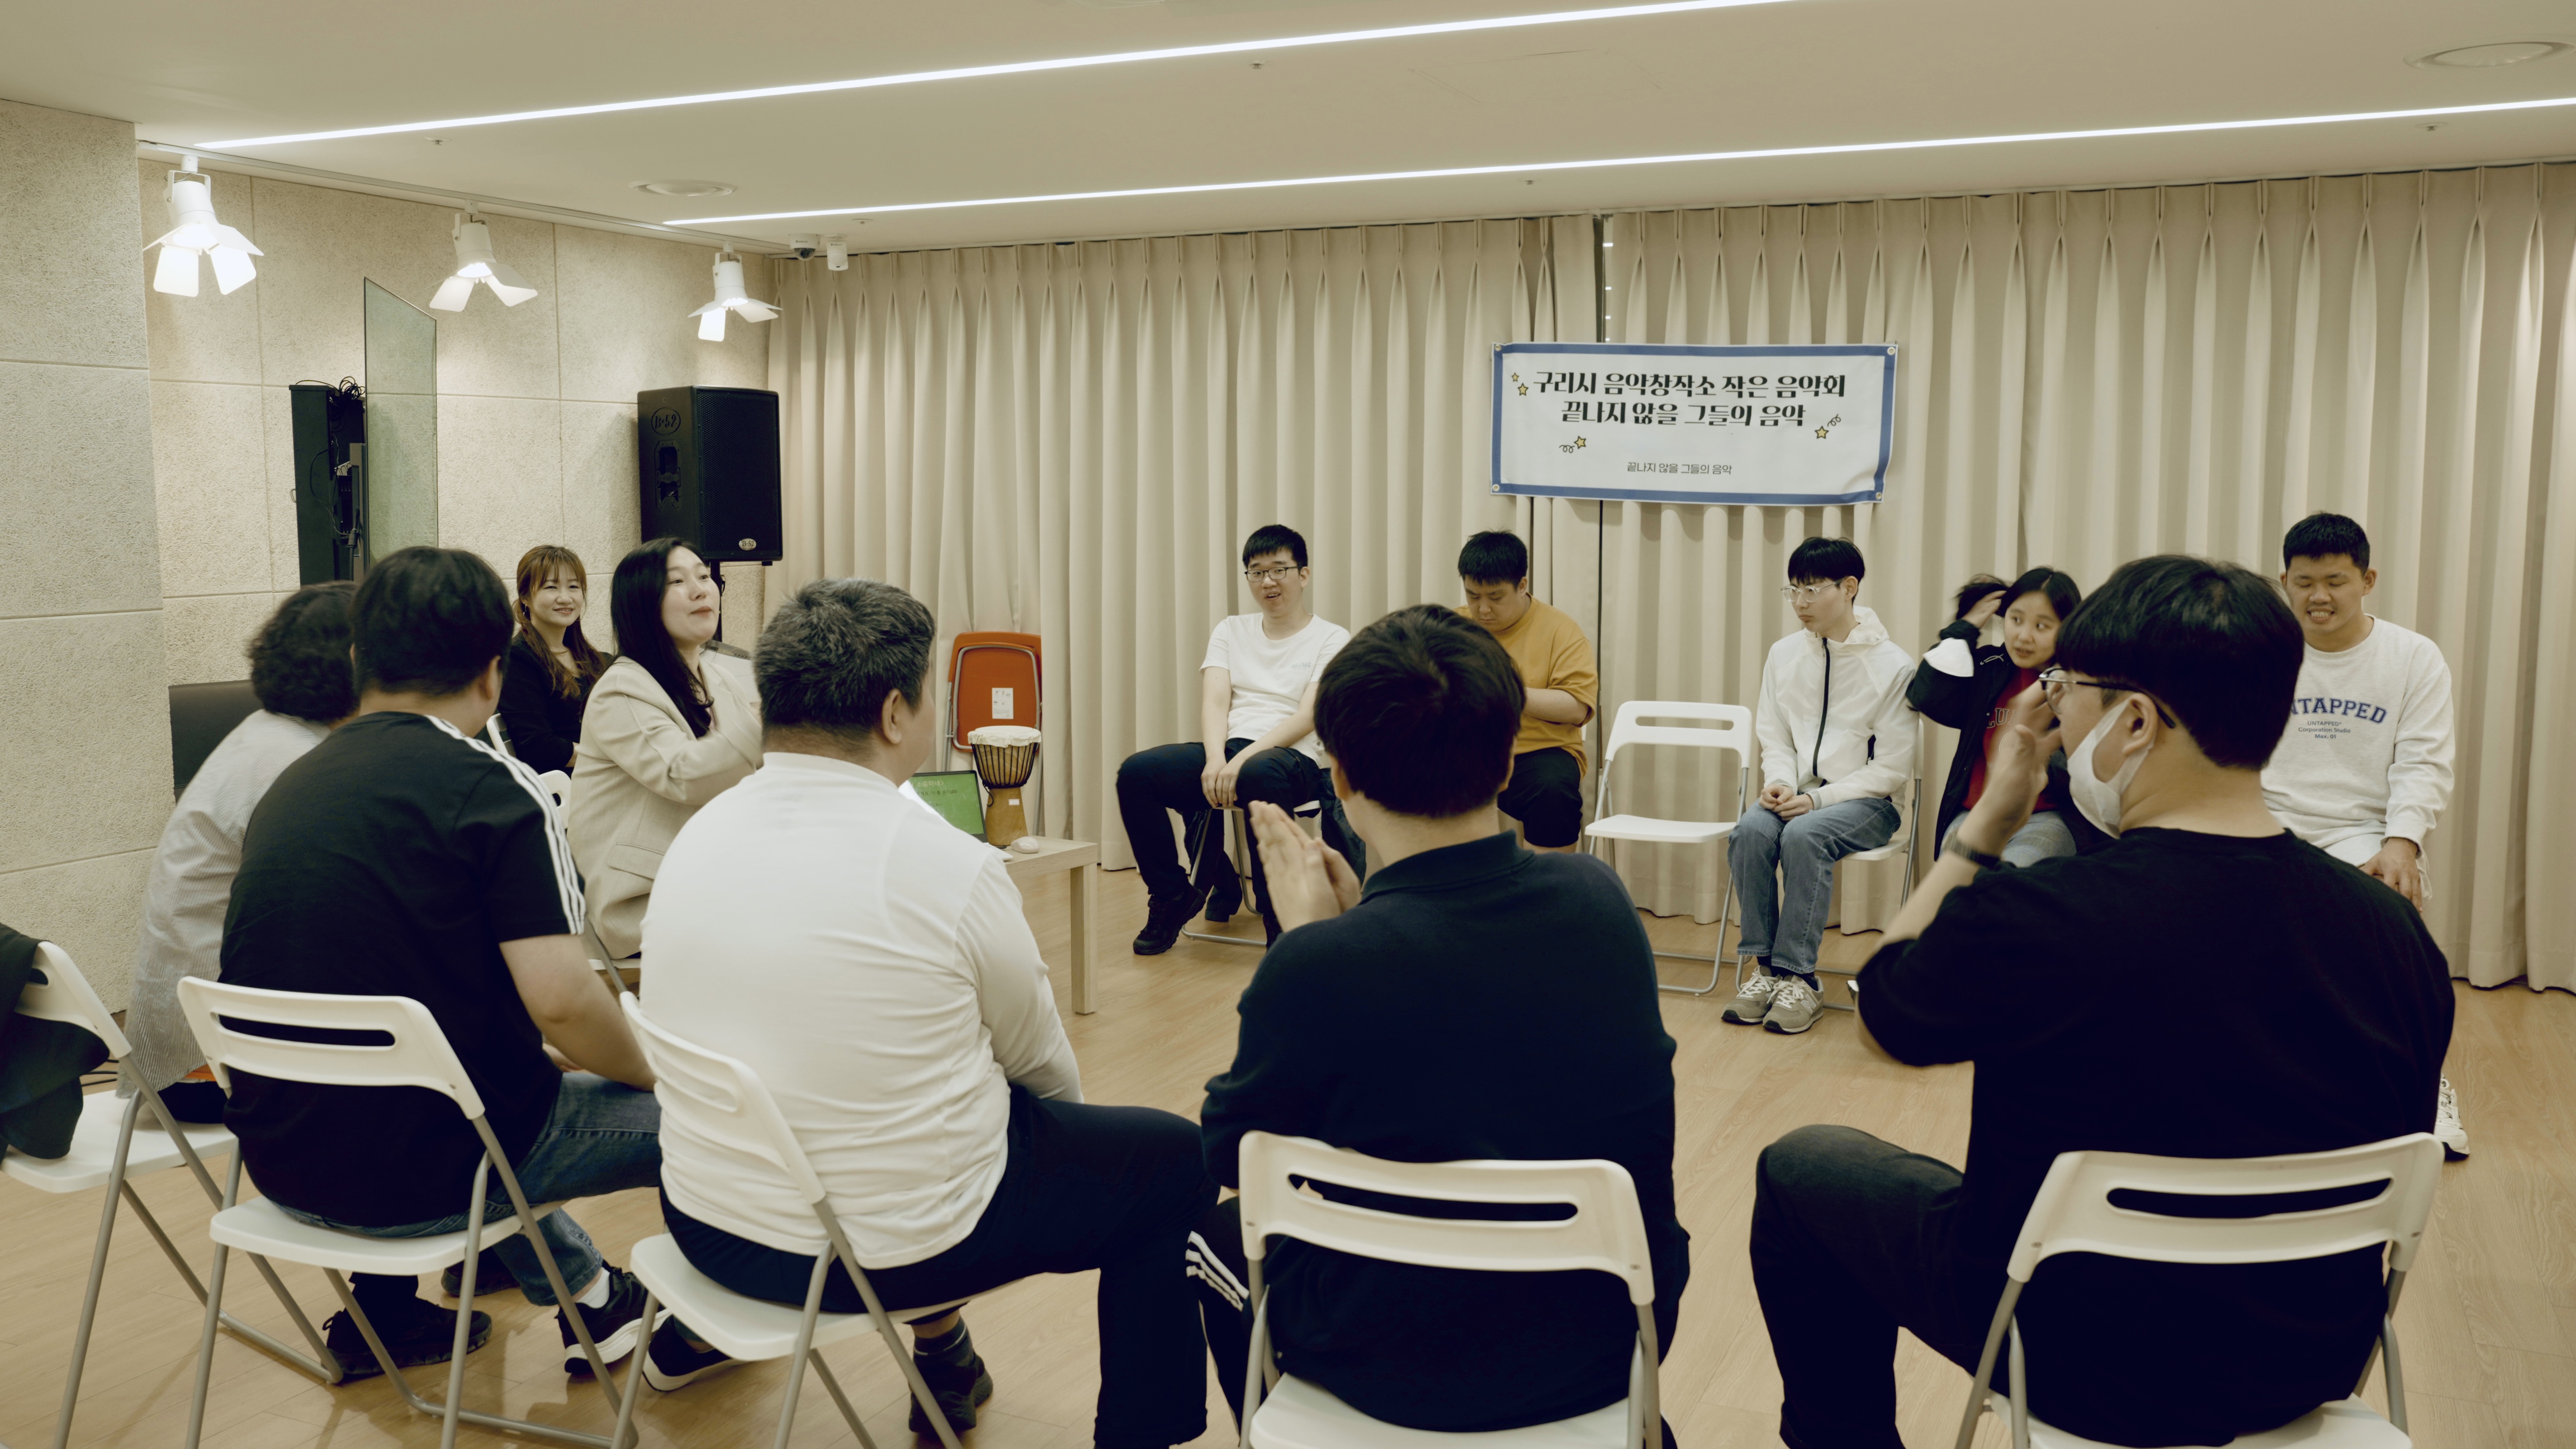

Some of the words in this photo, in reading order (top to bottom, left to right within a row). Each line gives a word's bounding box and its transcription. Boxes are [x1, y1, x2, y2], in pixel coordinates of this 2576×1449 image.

[1533, 372, 1597, 394] 구리시
[1604, 373, 1716, 397] 음악창작소
[1721, 376, 1769, 399] 작은
[1775, 375, 1845, 398] 음악회
[1562, 401, 1626, 424] 끝나지
[1632, 402, 1678, 425] 않을
[1684, 405, 1752, 426] 그들의
[1760, 405, 1806, 427] 음악
[1627, 462, 1656, 472] 끝나지
[1659, 463, 1678, 473] 않을
[1681, 464, 1710, 474] 그들의
[1712, 465, 1732, 475] 음악
[2290, 698, 2388, 724] NTAPPED
